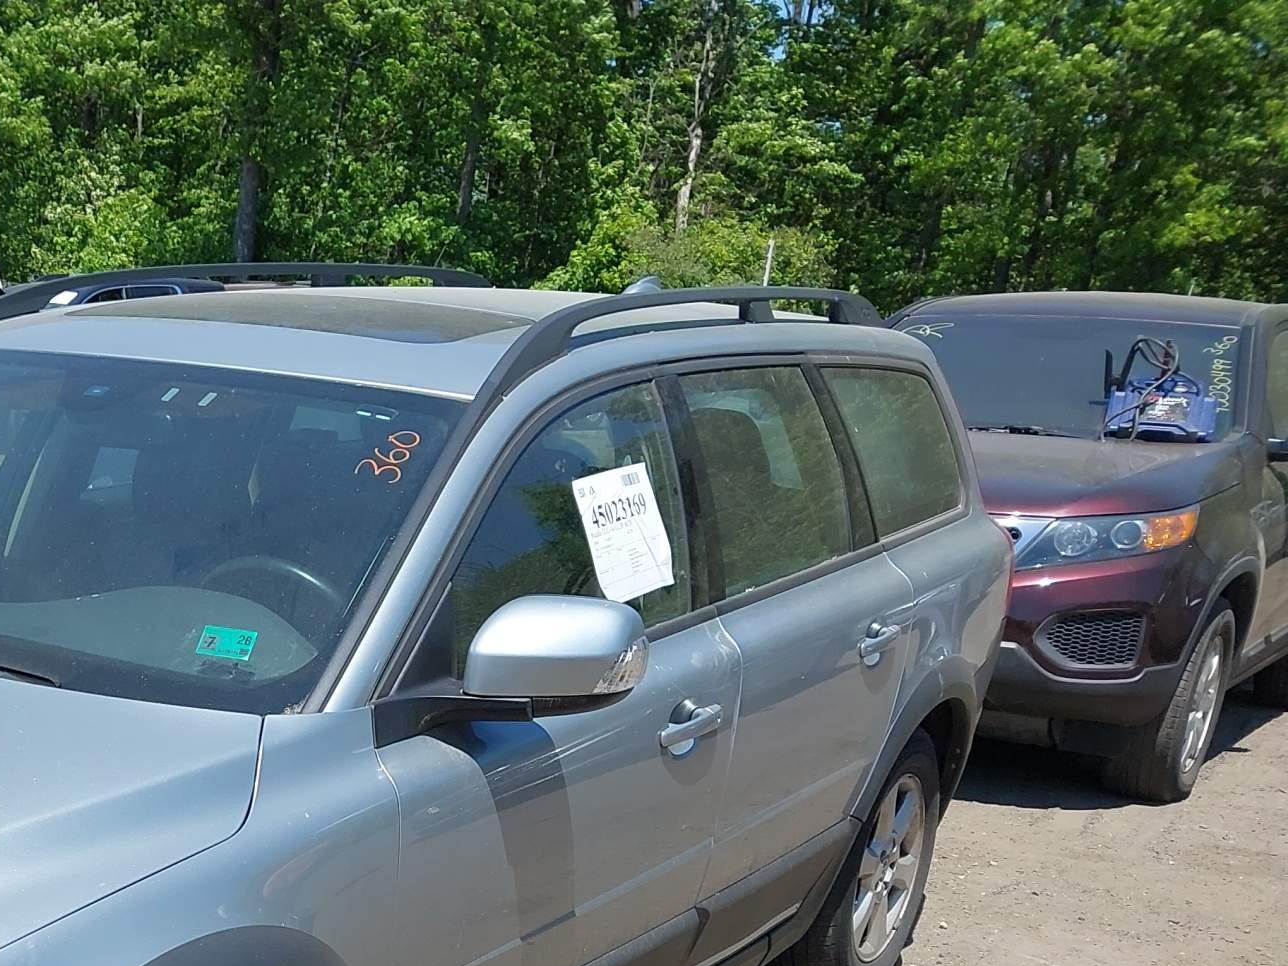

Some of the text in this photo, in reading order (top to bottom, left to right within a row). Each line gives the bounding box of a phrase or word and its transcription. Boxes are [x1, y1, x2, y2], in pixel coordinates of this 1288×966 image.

[354, 430, 420, 484] 360
[592, 492, 647, 529] 45023169
[237, 635, 252, 646] 26
